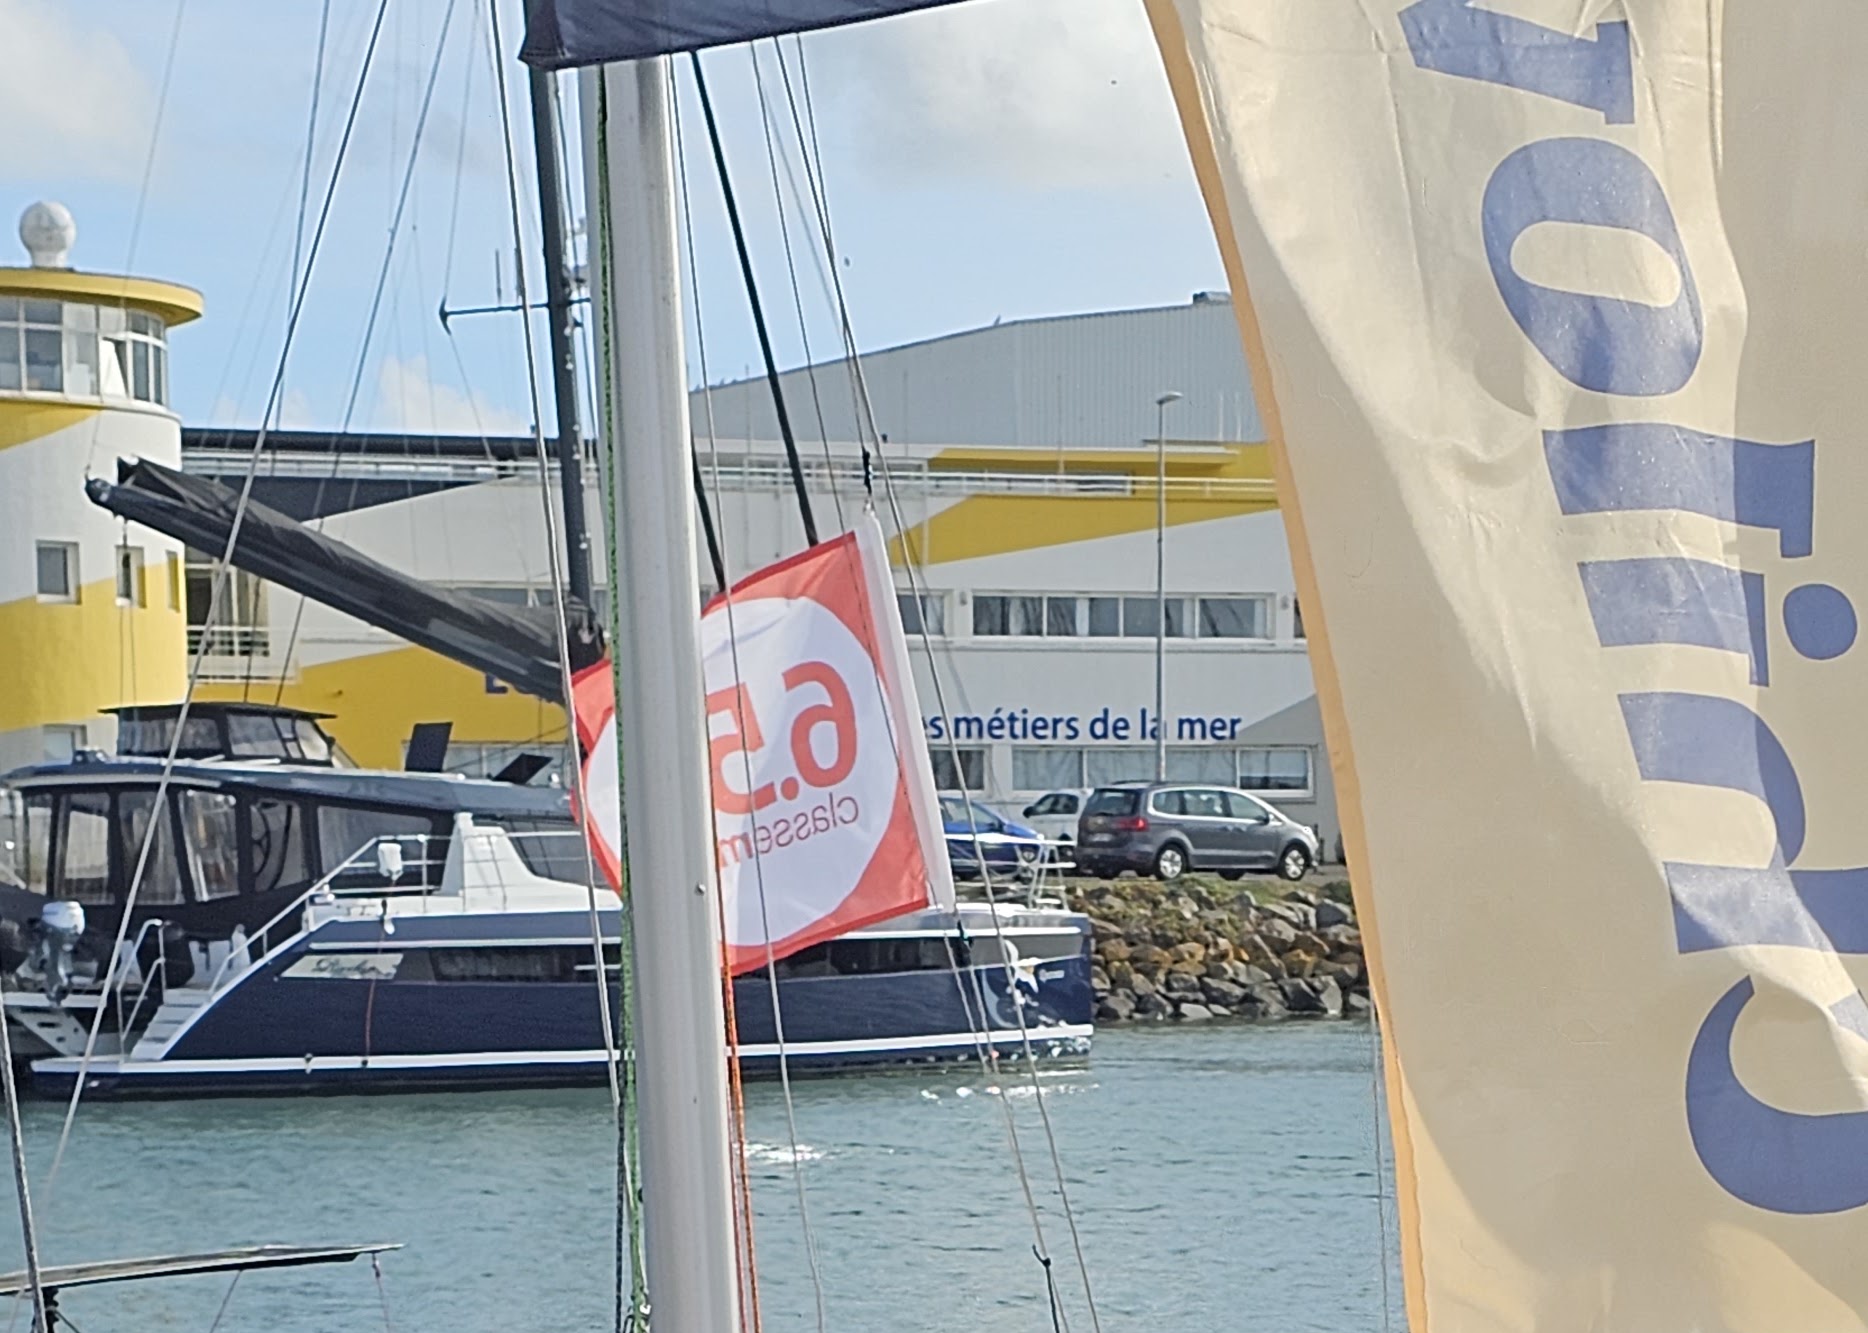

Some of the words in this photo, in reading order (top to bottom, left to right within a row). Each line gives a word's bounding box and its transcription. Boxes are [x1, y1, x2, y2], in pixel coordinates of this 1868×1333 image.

[922, 715, 943, 740] s
[953, 707, 1080, 740] métiers
[1089, 707, 1130, 740] de
[1140, 707, 1167, 740] la
[1177, 716, 1242, 740] mer
